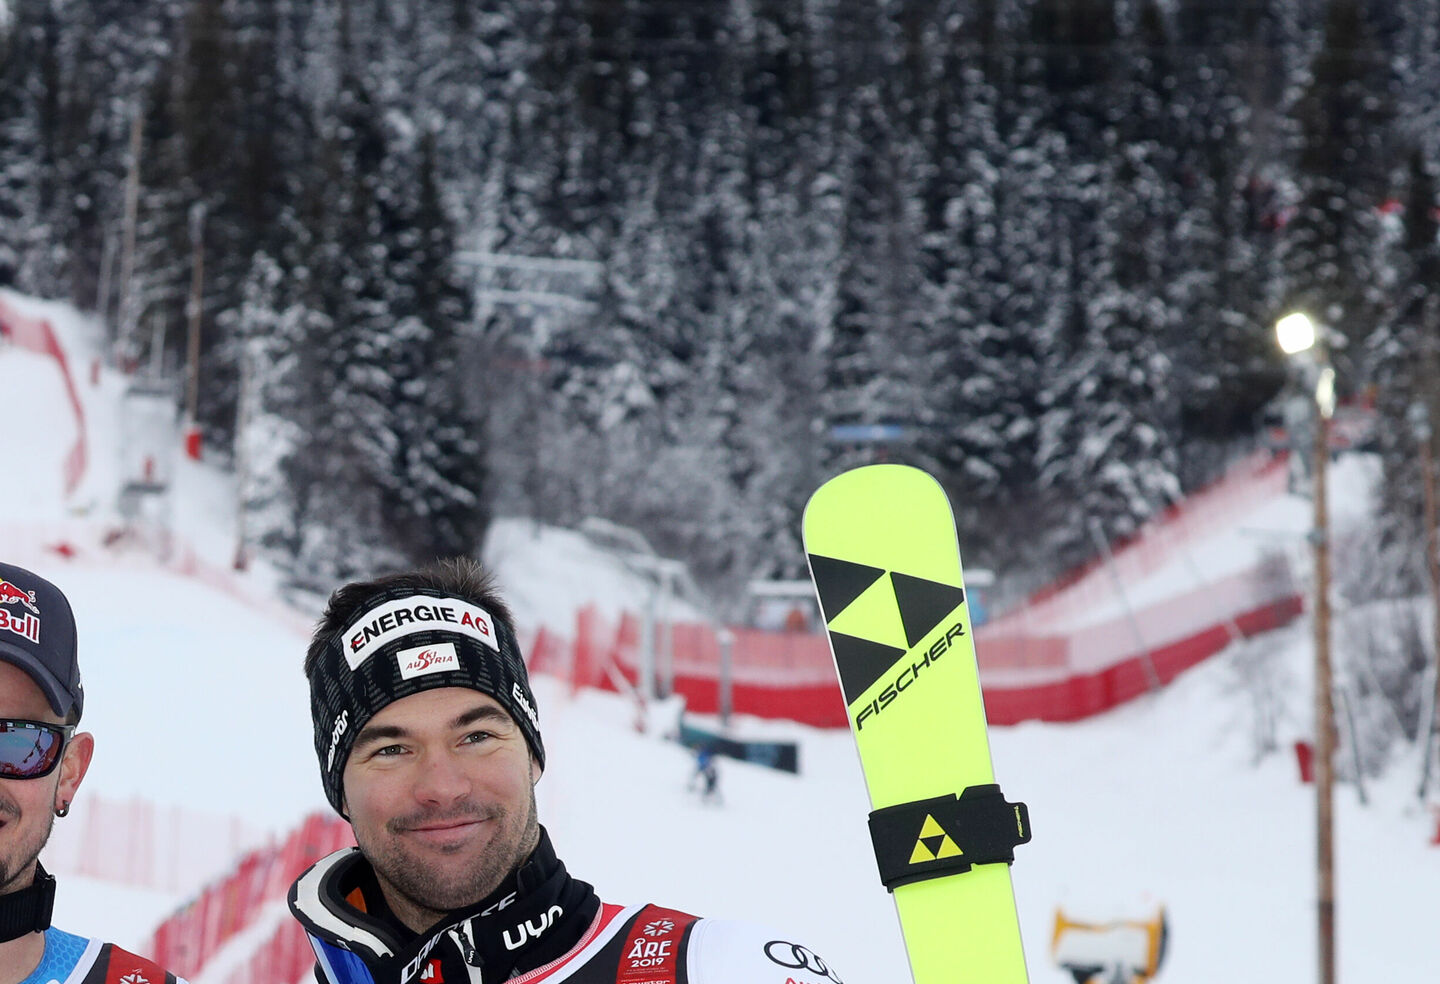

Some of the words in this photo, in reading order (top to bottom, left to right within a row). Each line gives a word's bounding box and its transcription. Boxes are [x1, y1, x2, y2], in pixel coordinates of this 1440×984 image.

[350, 605, 458, 654] ENERGIE
[461, 611, 490, 637] AG
[855, 621, 966, 731] FISCHER
[627, 937, 672, 959] ÅRE
[630, 957, 664, 968] 2019
